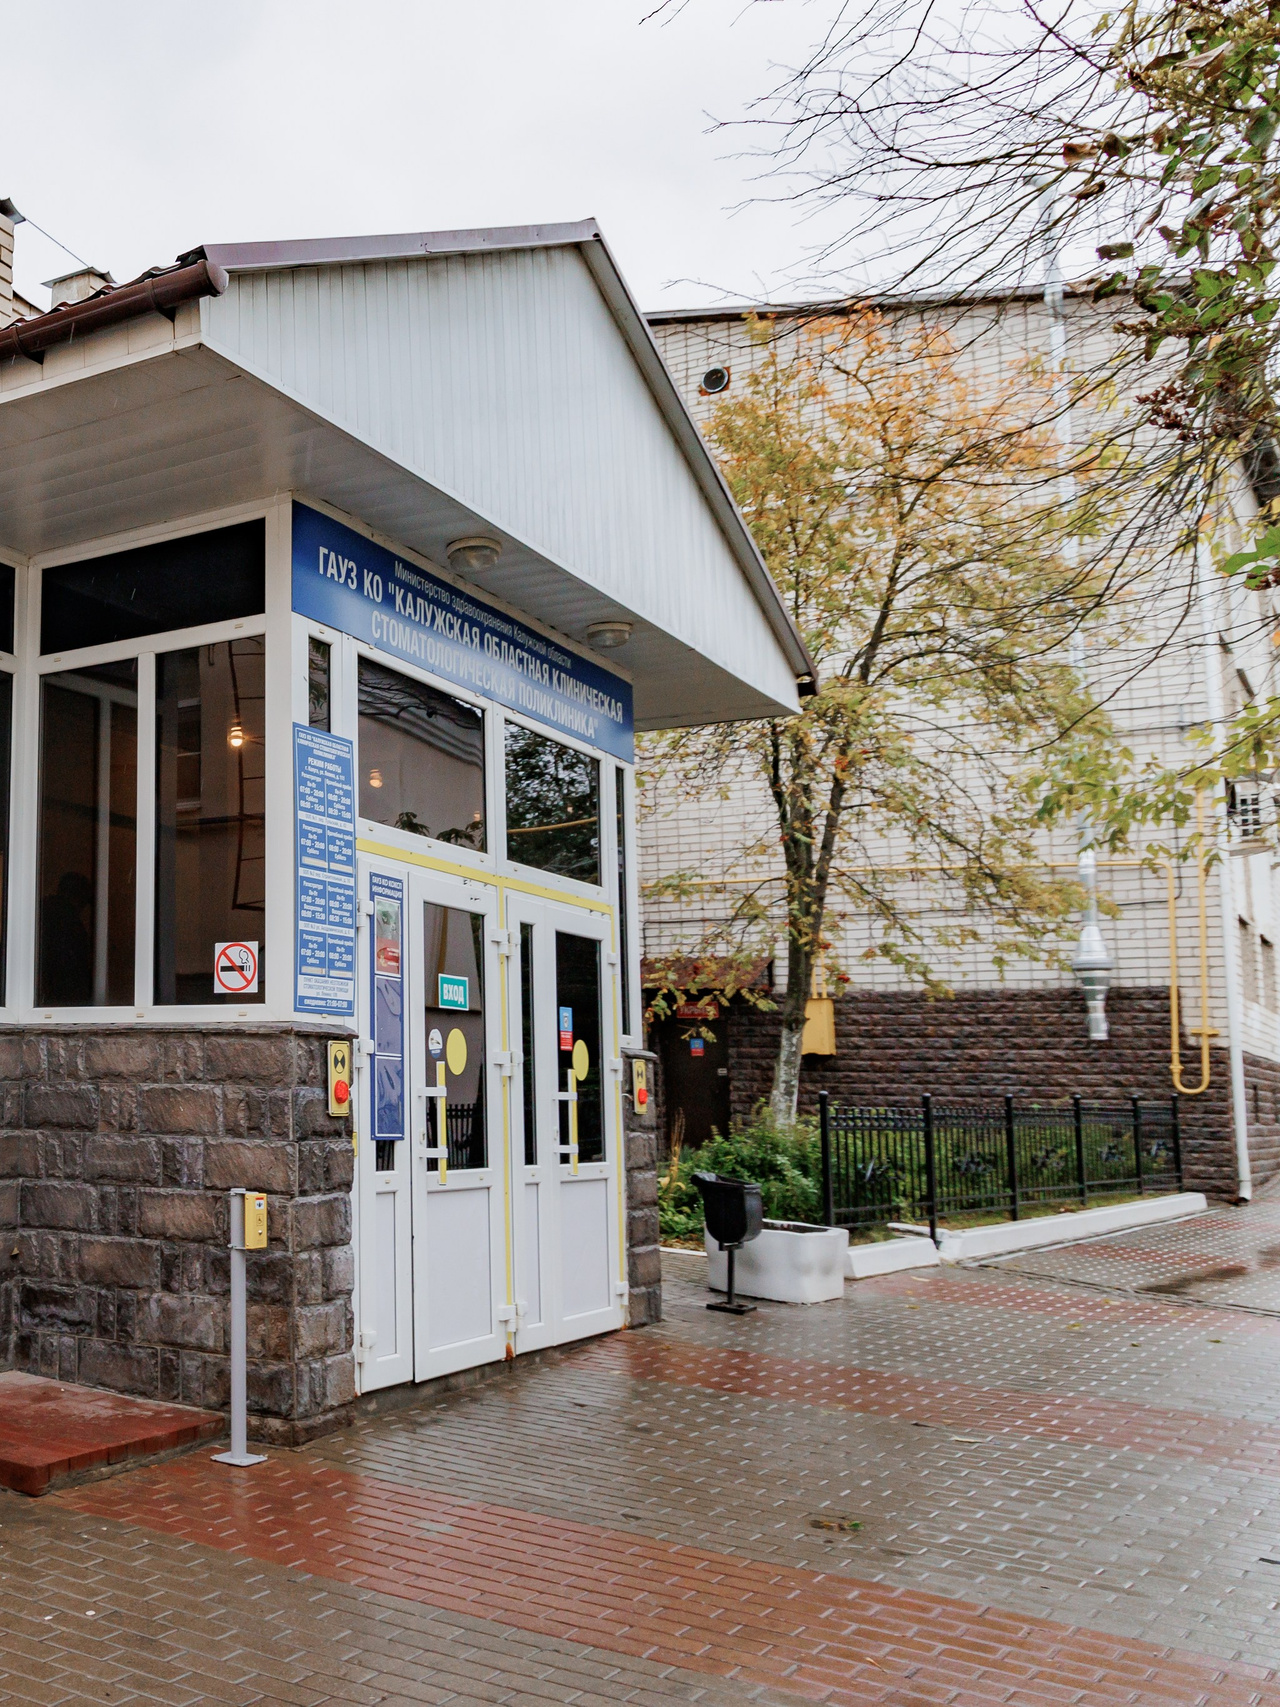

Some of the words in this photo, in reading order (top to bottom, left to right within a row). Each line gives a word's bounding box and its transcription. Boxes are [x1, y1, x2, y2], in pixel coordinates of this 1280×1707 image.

[318, 546, 358, 590] ГАУЗ
[363, 568, 383, 604] КО
[388, 581, 480, 651] "КАЛУЖСКАЯ
[484, 632, 550, 685] ОБЛАСТНАЯ
[552, 669, 624, 724] КЛИНИЧЕСКАЯ
[394, 560, 451, 604] Министерство
[452, 593, 513, 638] здравоохранения
[514, 623, 546, 656] Калужской
[547, 643, 572, 668] области
[372, 610, 516, 702] СТОМАТОЛОГИЧЕСКАЯ
[518, 681, 598, 739] ПОЛИКЛИНИКА"
[324, 762, 342, 773] РАБОТЫ
[443, 984, 464, 1005] ВХОД
